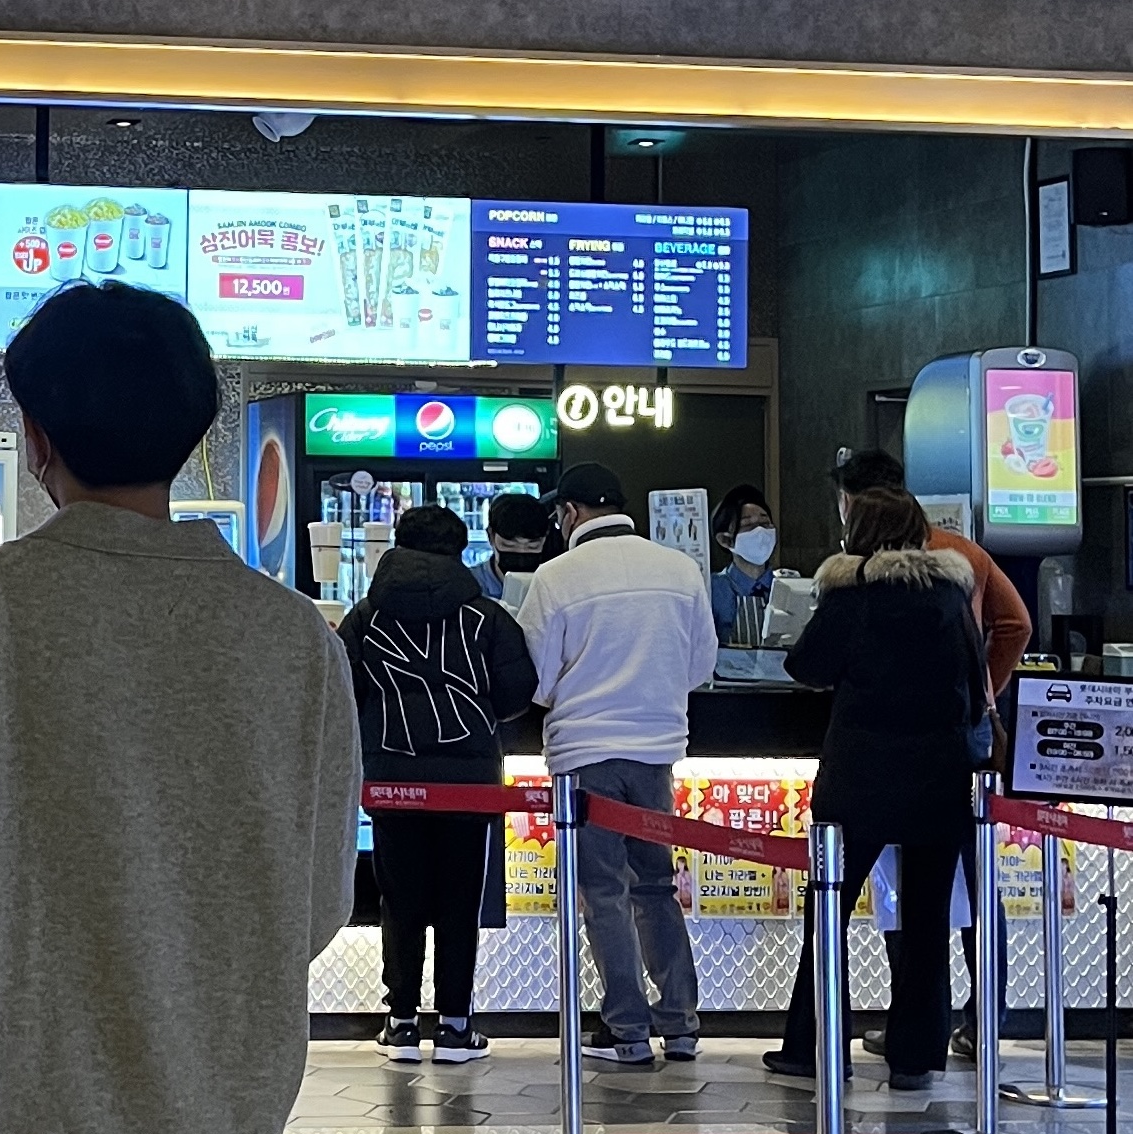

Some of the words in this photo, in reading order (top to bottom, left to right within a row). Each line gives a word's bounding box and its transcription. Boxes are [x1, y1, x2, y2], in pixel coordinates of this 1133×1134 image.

[488, 209, 545, 222] POPCORN
[199, 228, 275, 254] 삼진어묵
[281, 230, 325, 257] 콤보!
[488, 236, 529, 249] SNACK
[654, 242, 716, 256] BEVERAGE
[603, 384, 674, 428] 안내
[419, 440, 455, 453] pepsi
[362, 604, 498, 757] NY
[712, 783, 731, 804] 아
[736, 783, 771, 805] 맞다
[728, 808, 778, 830] 팝콘!!
[509, 866, 529, 879] 나는
[704, 869, 724, 881] 나는
[699, 885, 740, 897] 오리지널
